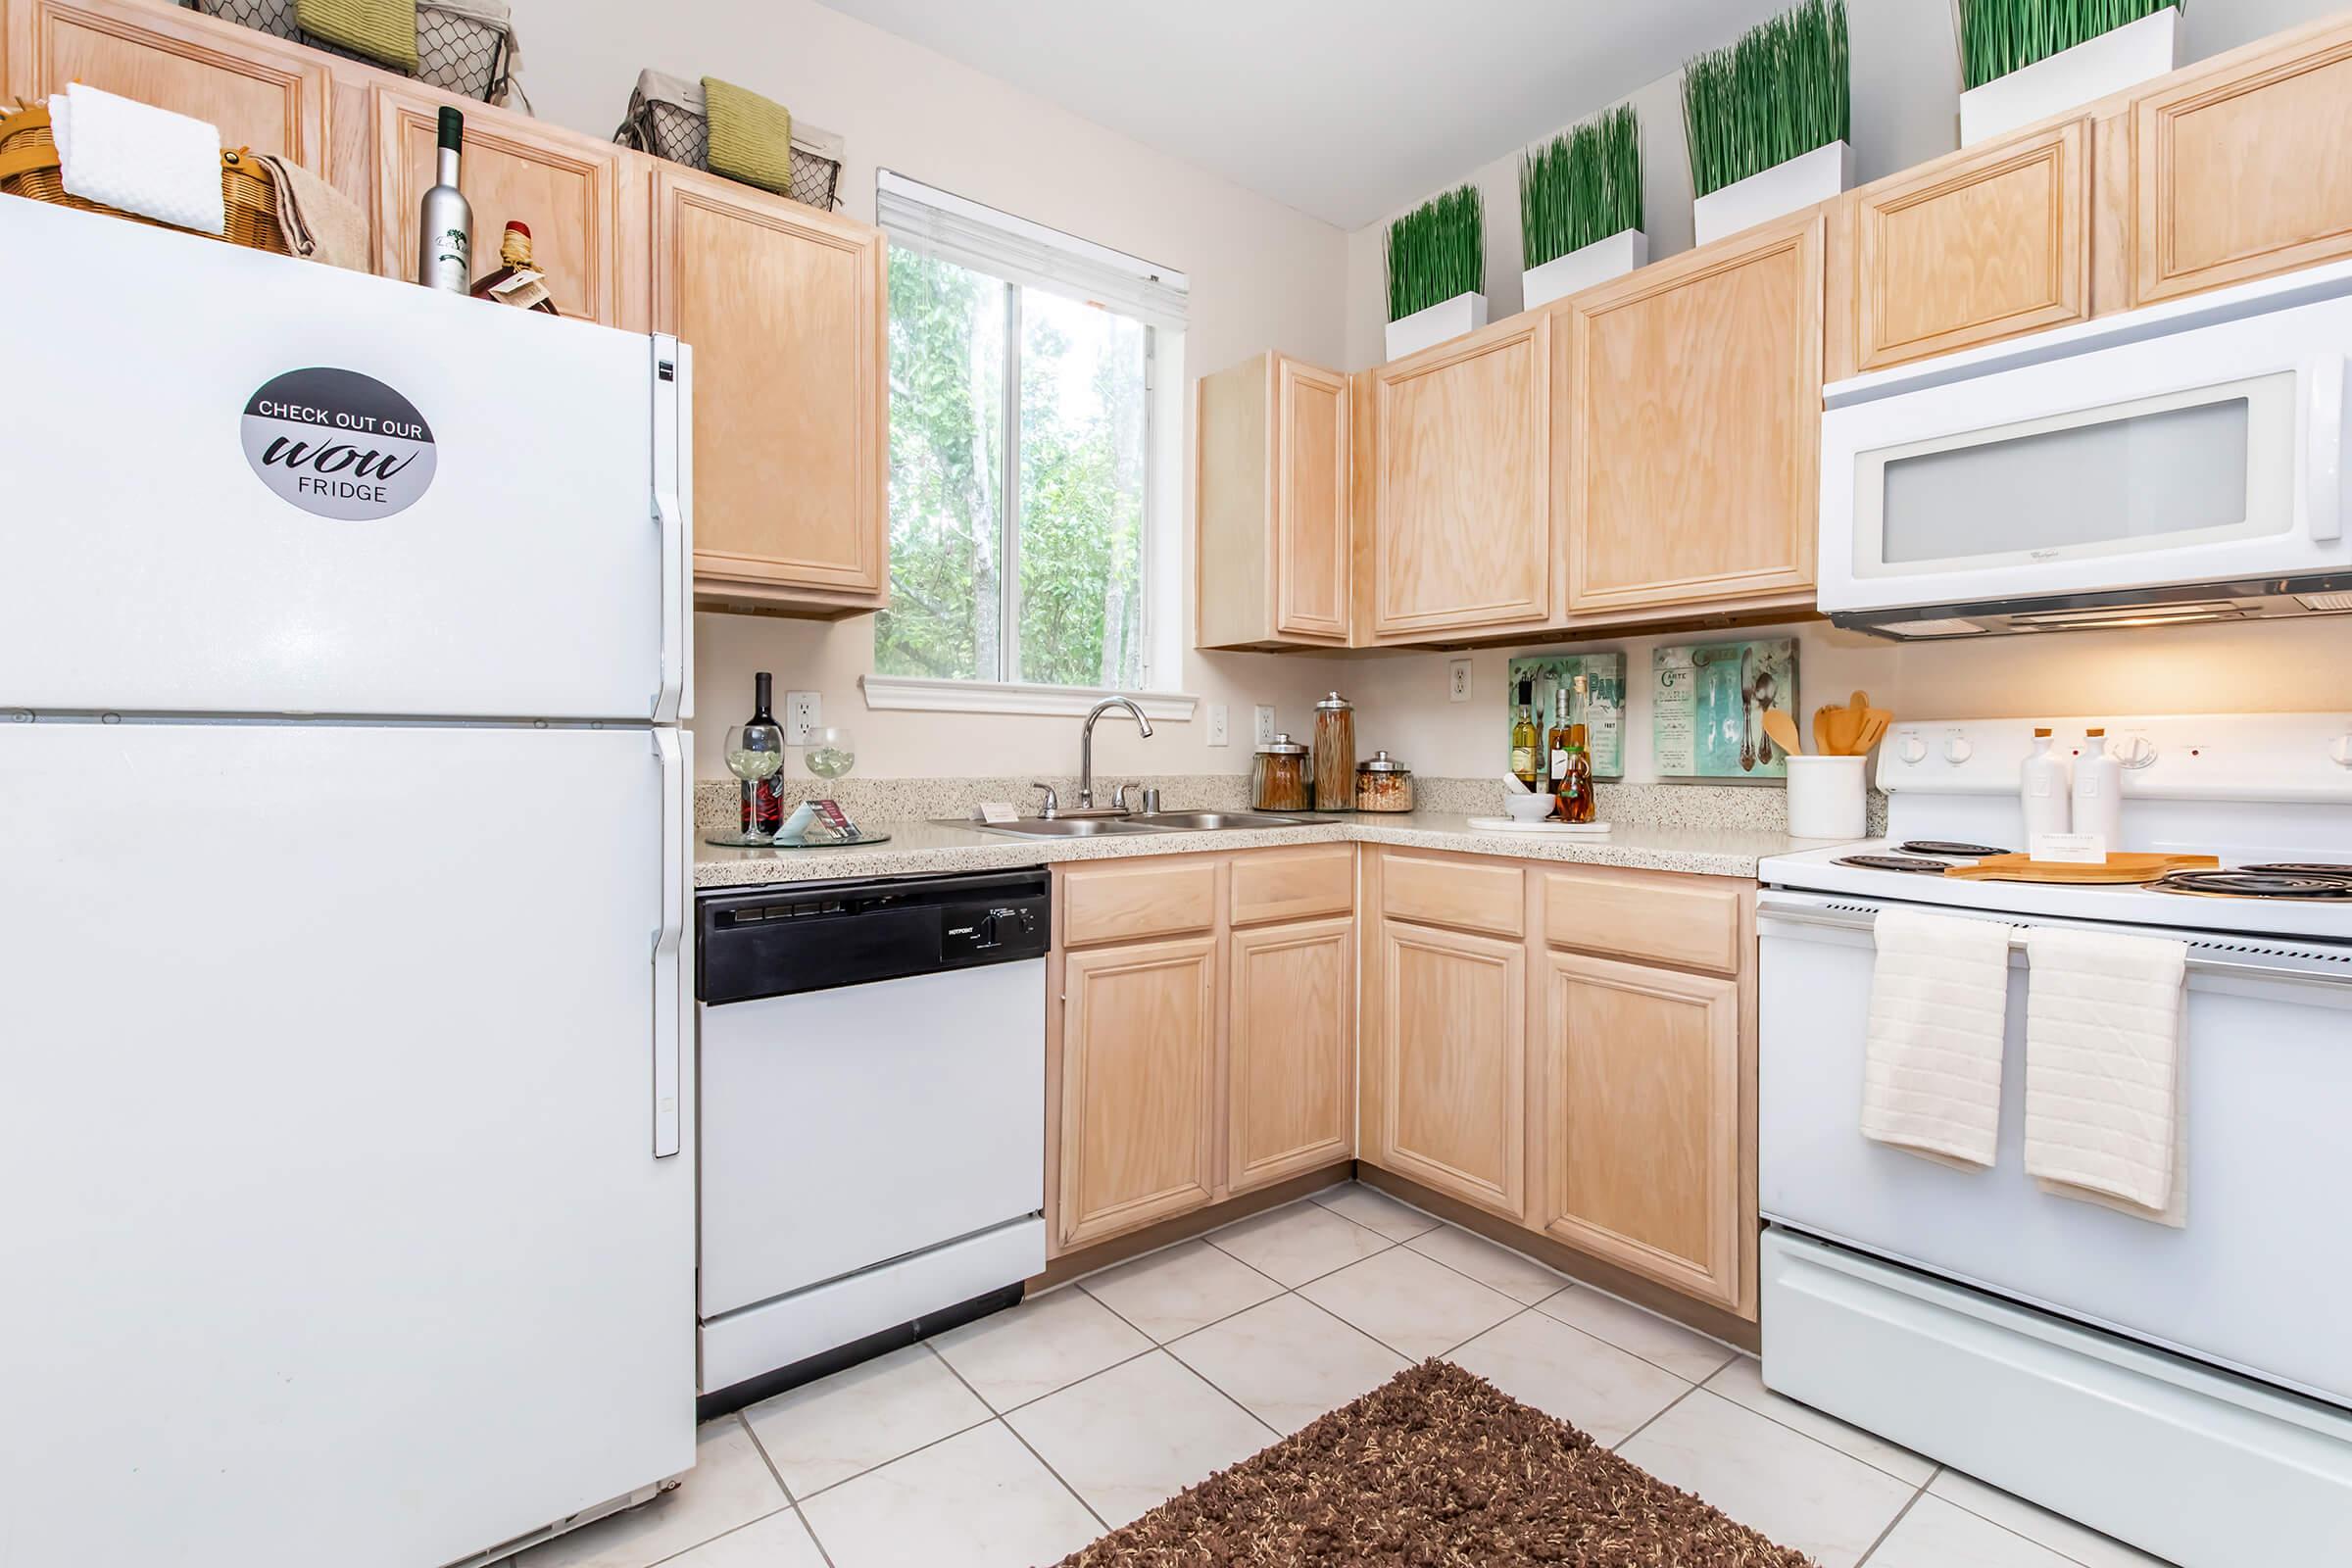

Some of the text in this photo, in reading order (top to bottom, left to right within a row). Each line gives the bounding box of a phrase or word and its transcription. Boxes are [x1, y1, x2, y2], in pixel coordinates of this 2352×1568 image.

[259, 401, 422, 438] CHECK OUT OUR
[262, 436, 420, 480] wow
[298, 476, 387, 503] FRIDGE
